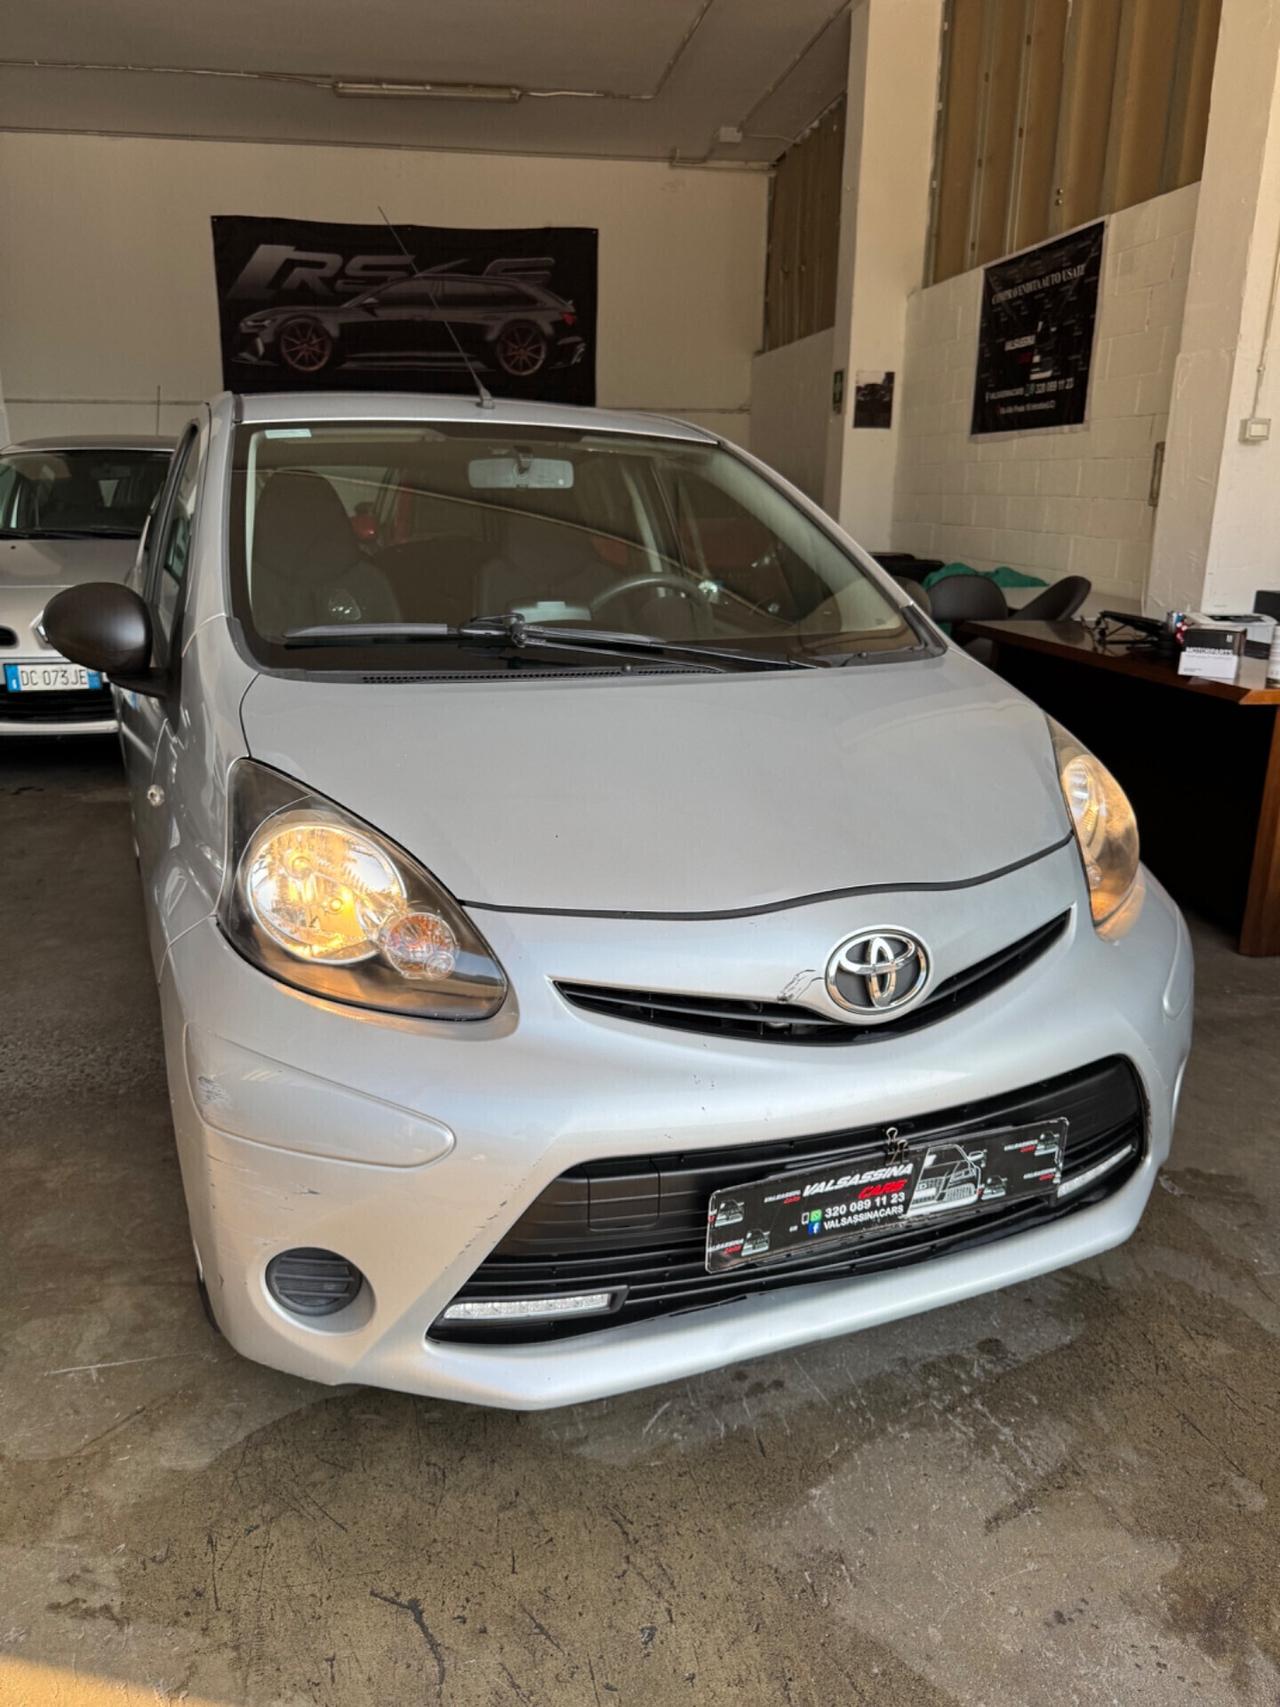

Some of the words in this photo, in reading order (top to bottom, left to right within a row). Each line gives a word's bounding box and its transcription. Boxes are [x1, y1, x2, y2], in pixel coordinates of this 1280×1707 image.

[21, 670, 38, 686] DC
[802, 1163, 914, 1197] VALSASSINA
[858, 1178, 908, 1200] CARS
[823, 1204, 905, 1231] VALSASSINACARS
[824, 1204, 847, 1219] 320
[849, 1200, 872, 1213] 089
[874, 1195, 887, 1207] 11
[890, 1192, 906, 1204] 23
